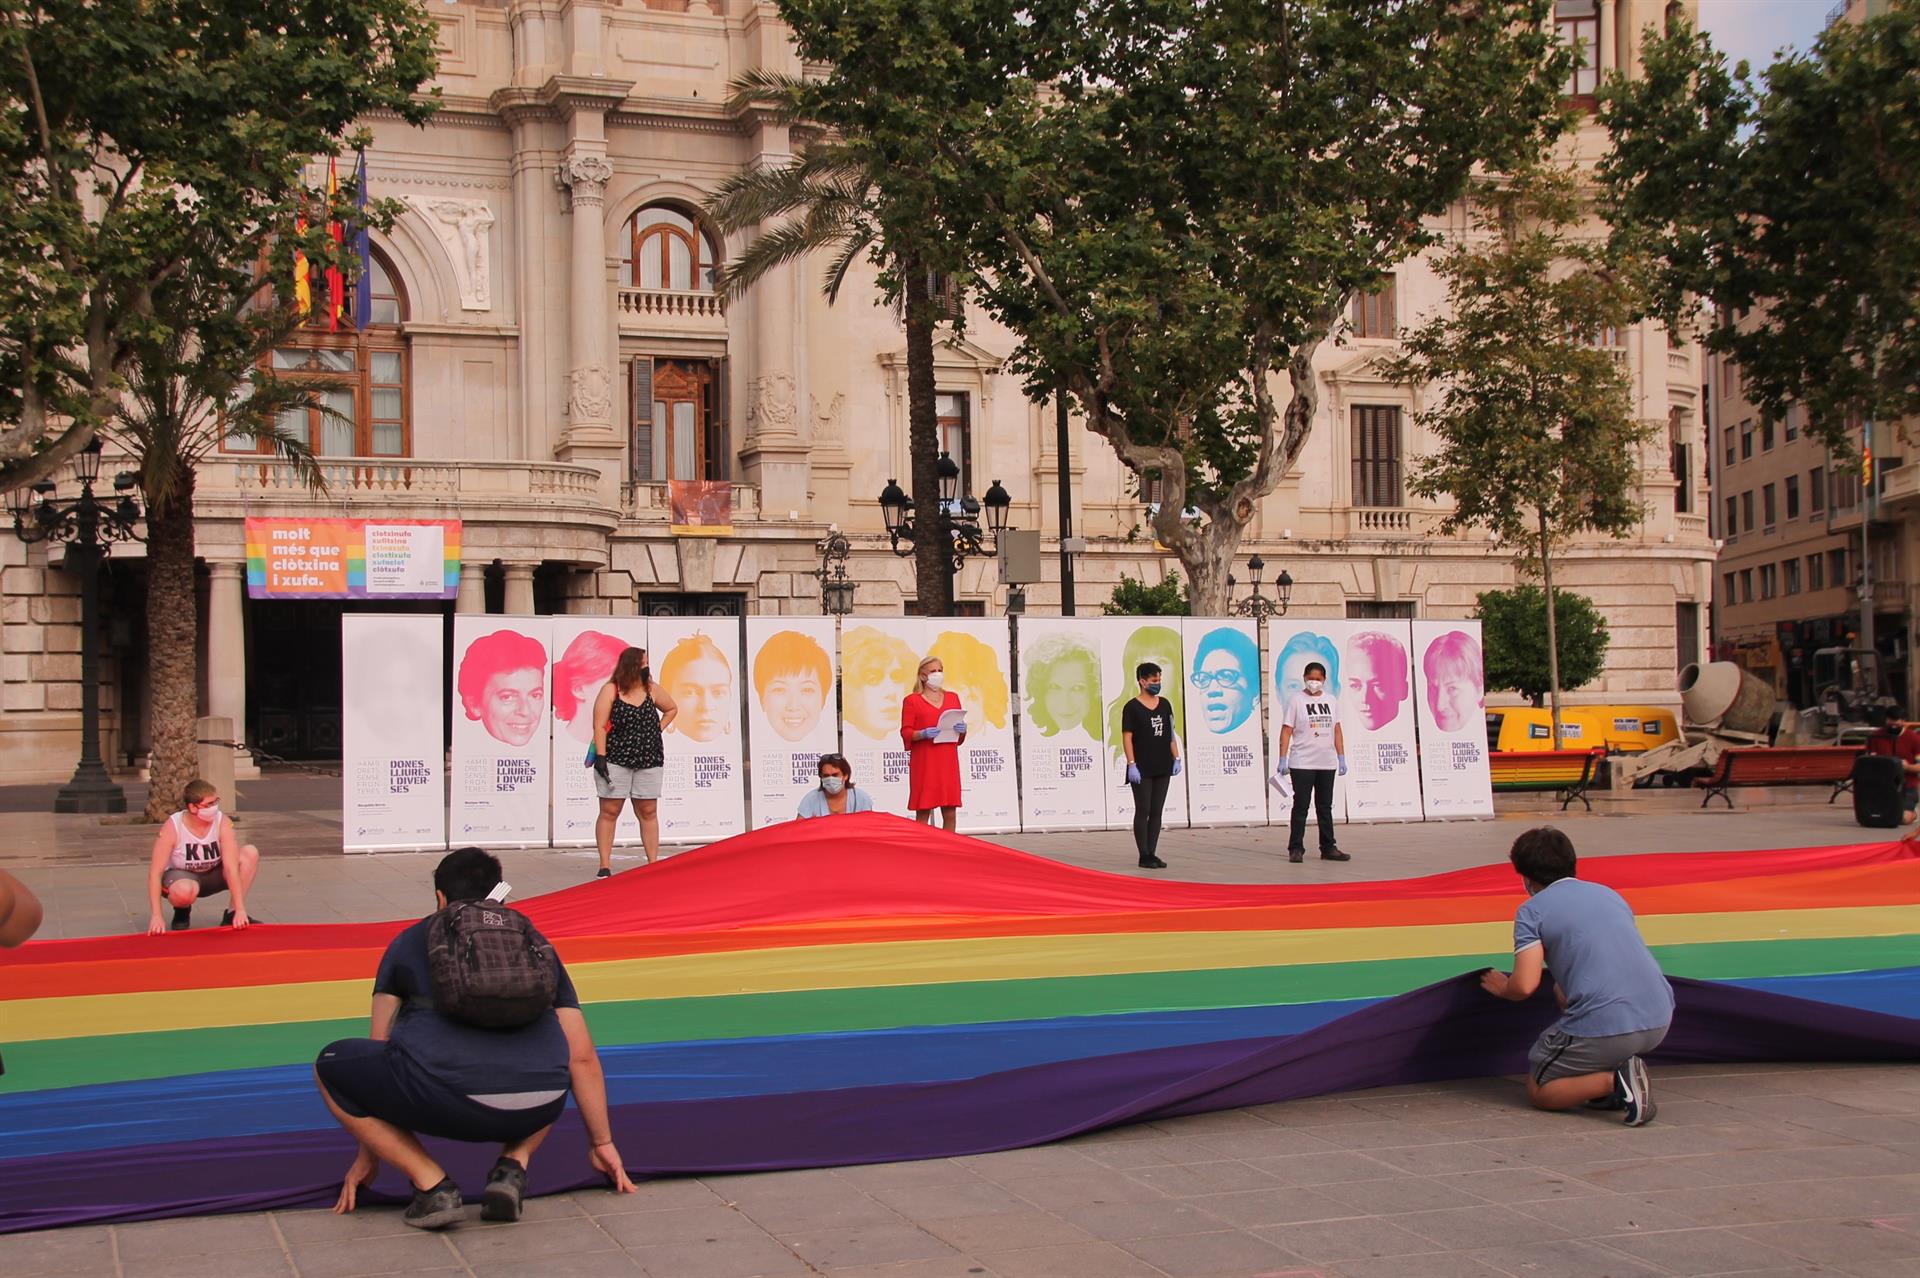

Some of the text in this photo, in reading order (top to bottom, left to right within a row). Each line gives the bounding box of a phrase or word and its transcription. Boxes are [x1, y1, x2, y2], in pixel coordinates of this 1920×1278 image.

[272, 528, 310, 540] molt
[272, 543, 340, 558] més que
[272, 559, 339, 571] clòtxina
[273, 574, 324, 586] i xufa.
[1306, 703, 1331, 715] KM
[390, 760, 424, 768] DONES
[497, 759, 530, 767] DONES
[694, 756, 725, 764] DONES
[390, 768, 430, 776] LLIURES
[694, 764, 731, 772] LLIURES
[971, 772, 987, 780] SES
[397, 777, 429, 785] DIVER-
[390, 785, 409, 793] SES
[185, 841, 221, 861] KM
